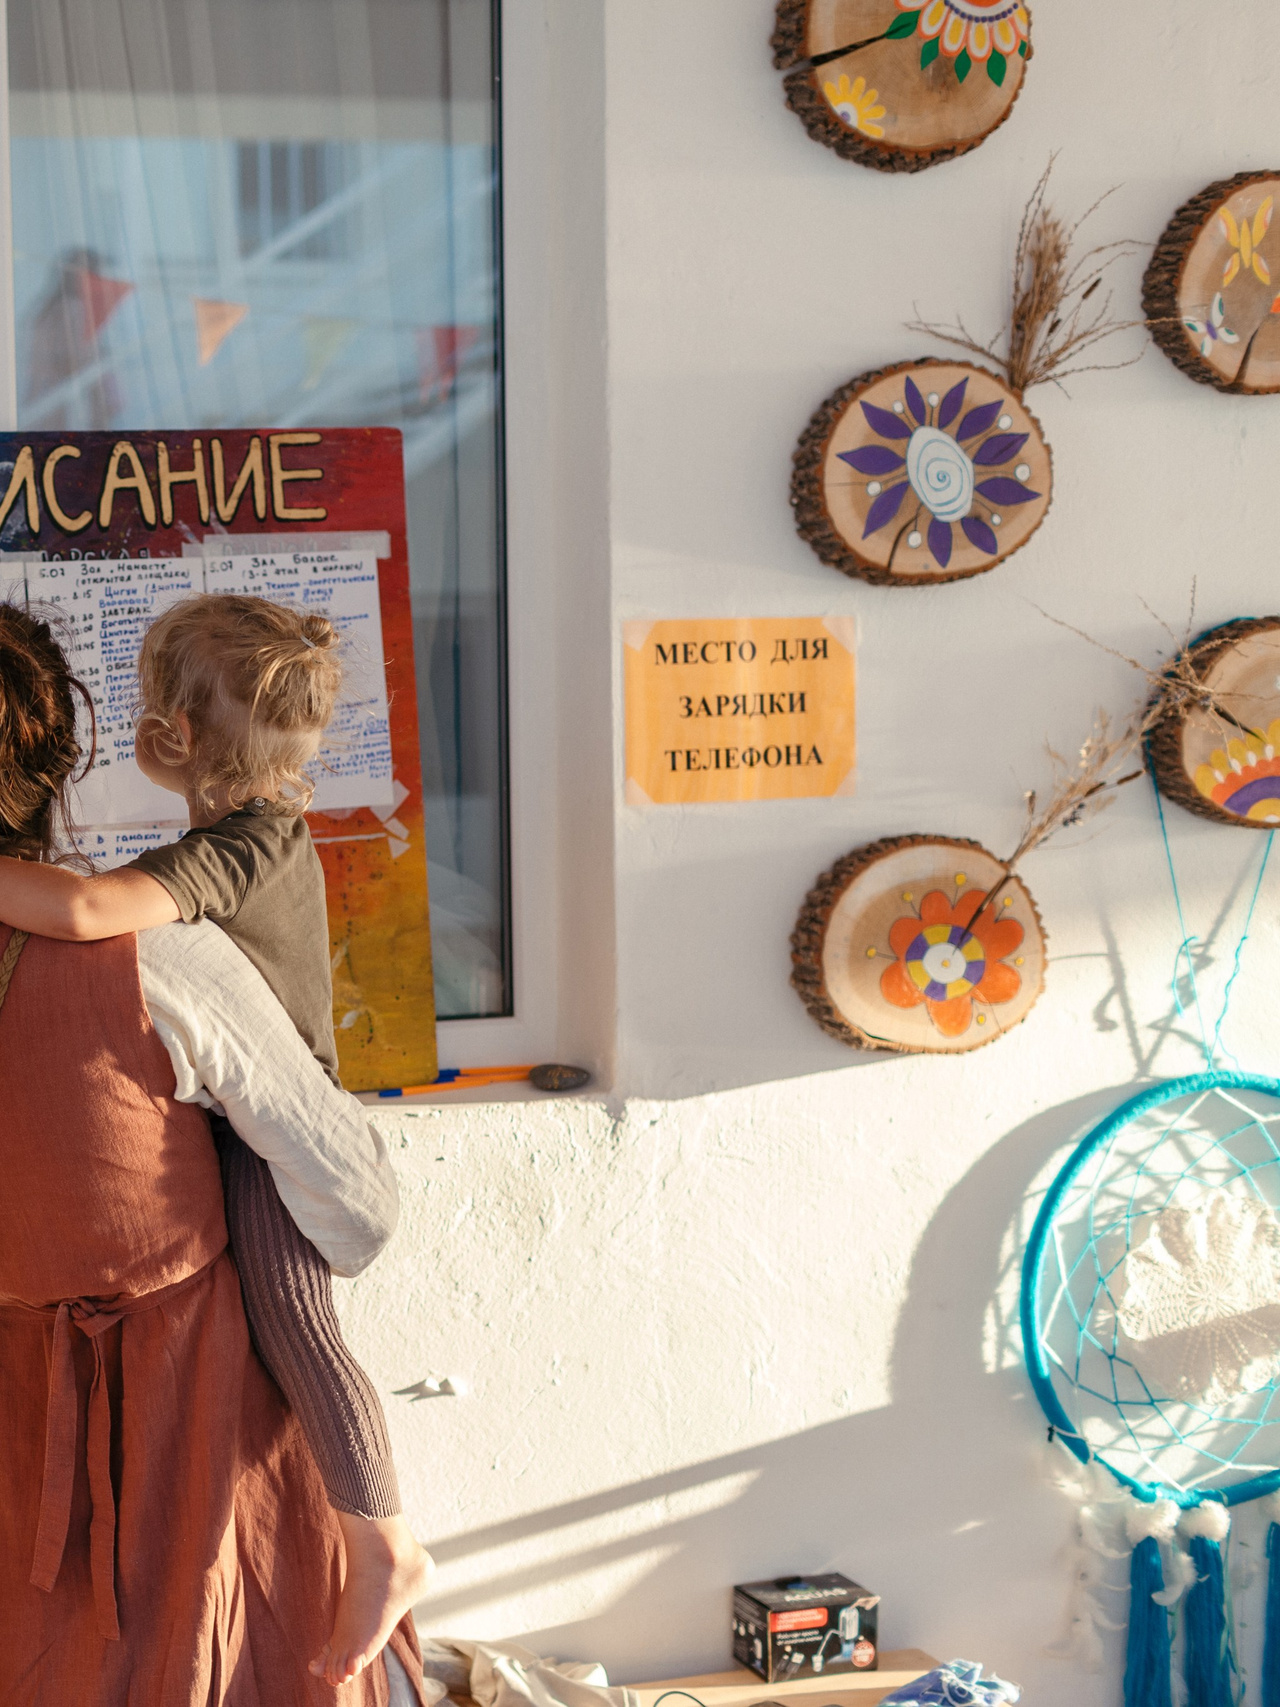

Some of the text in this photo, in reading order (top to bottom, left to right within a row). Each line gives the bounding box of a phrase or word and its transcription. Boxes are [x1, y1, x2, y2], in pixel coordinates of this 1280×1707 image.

[655, 637, 829, 666] МЕСТО ДЛЯ
[679, 691, 807, 719] ЗАРЯДКИ
[664, 744, 824, 773] ТЕЛЕФОНА
